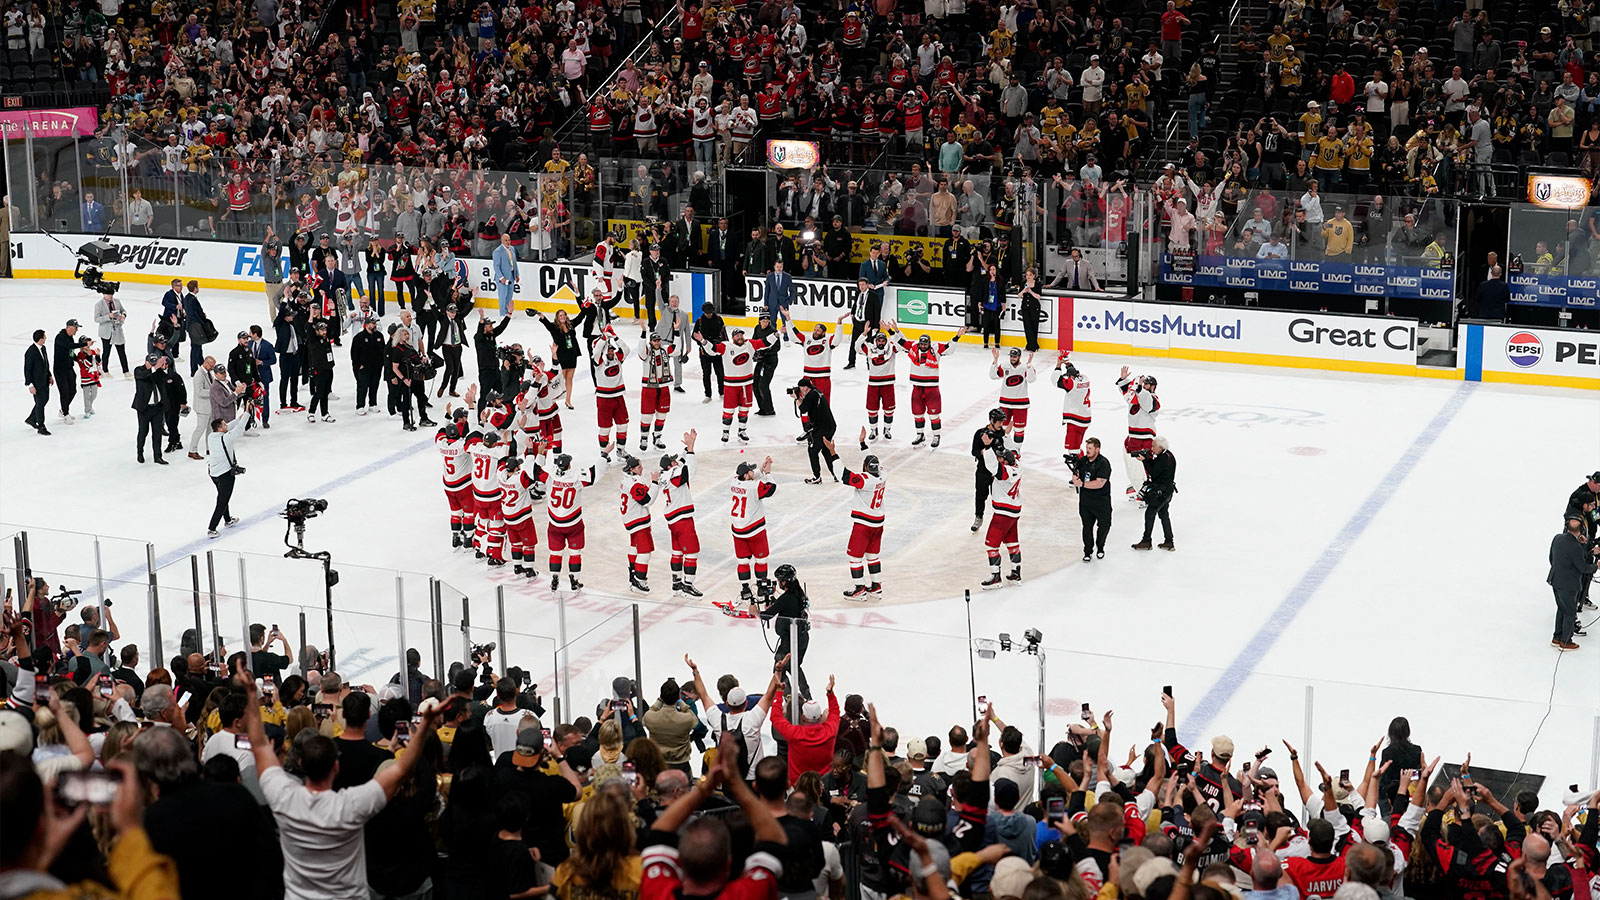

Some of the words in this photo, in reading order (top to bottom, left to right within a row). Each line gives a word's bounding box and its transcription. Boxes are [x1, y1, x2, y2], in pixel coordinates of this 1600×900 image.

[8, 98, 20, 107] EXIT
[23, 120, 69, 131] ARENA
[98, 236, 189, 270] nergizer
[1226, 258, 1256, 269] UMC
[1289, 262, 1320, 273] UMC
[1258, 269, 1288, 280] UMC
[1354, 265, 1385, 276] UMC
[1420, 269, 1451, 280] UMC
[540, 265, 589, 299] CAT
[1163, 272, 1193, 283] UMC
[1226, 276, 1256, 287] UMC
[1321, 273, 1352, 284] UMC
[1387, 276, 1418, 287] UMC
[1510, 275, 1539, 286] UMC
[1289, 280, 1319, 291] UMC
[1354, 284, 1384, 295] UMC
[1567, 279, 1597, 289] UMC
[1419, 288, 1450, 298] UMC
[1538, 286, 1567, 296] UMC
[1509, 292, 1538, 303] UMC
[1567, 296, 1596, 306] UMC
[1104, 309, 1241, 340] MassMutual
[1288, 318, 1377, 348] Great
[1508, 344, 1541, 355] PEPSI
[444, 456, 455, 475] 5
[474, 457, 491, 480] 31
[550, 486, 577, 509] 50
[870, 487, 886, 509] 19
[730, 495, 748, 519] 21
[1203, 783, 1220, 797] AHO
[1307, 879, 1342, 893] JARVIS
